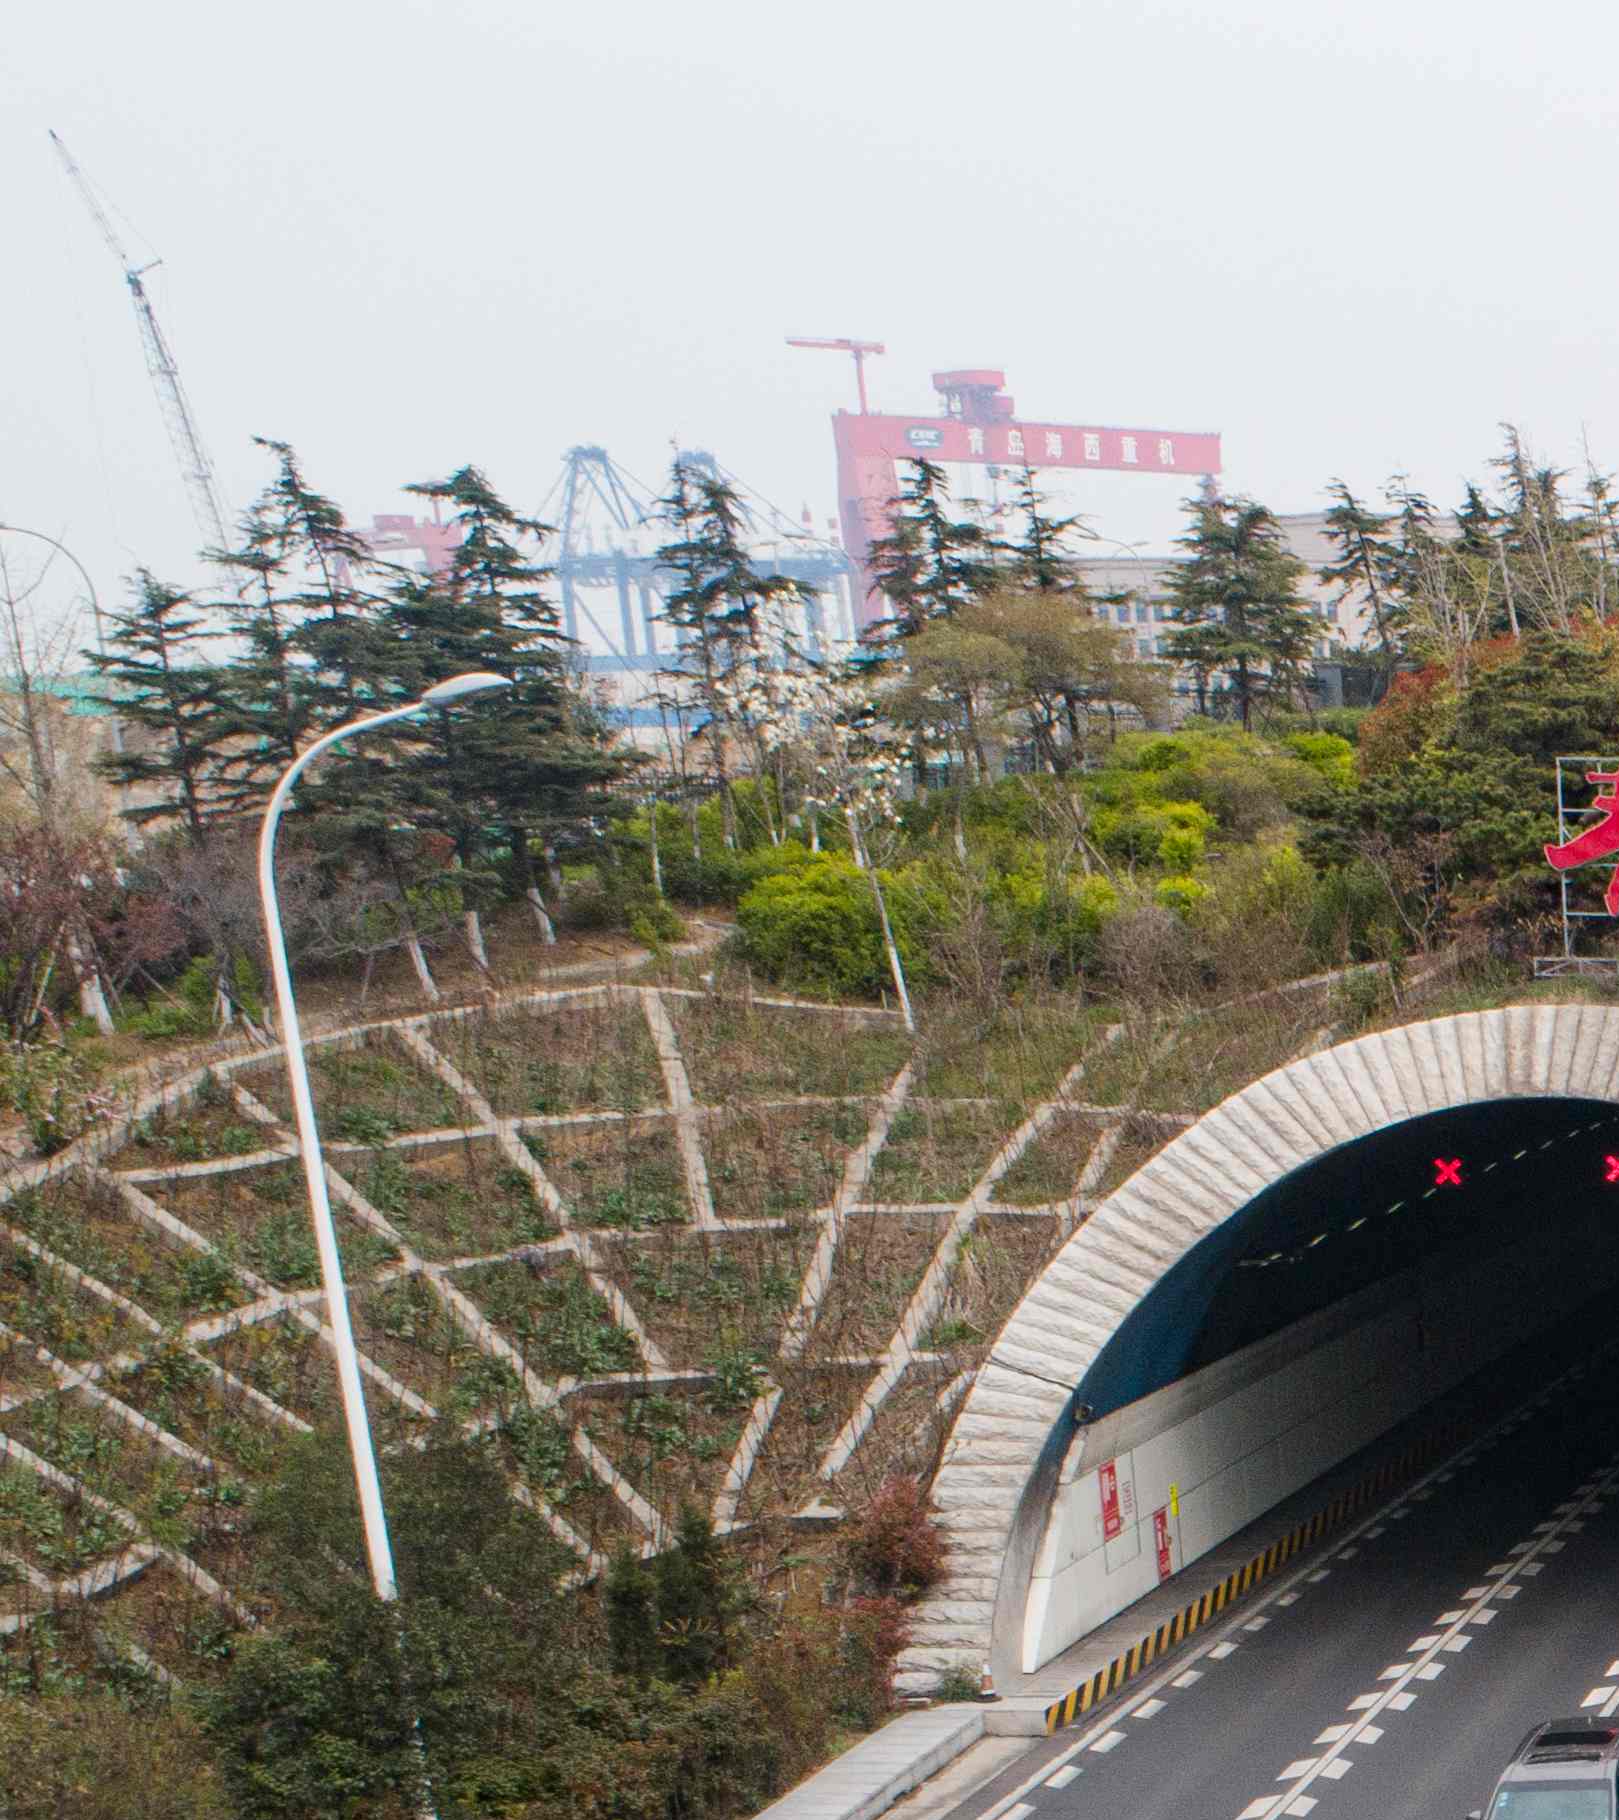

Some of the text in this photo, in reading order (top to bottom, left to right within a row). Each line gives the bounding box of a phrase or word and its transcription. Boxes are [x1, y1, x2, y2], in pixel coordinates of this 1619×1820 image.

[967, 427, 1175, 464] 青岛海西重机
